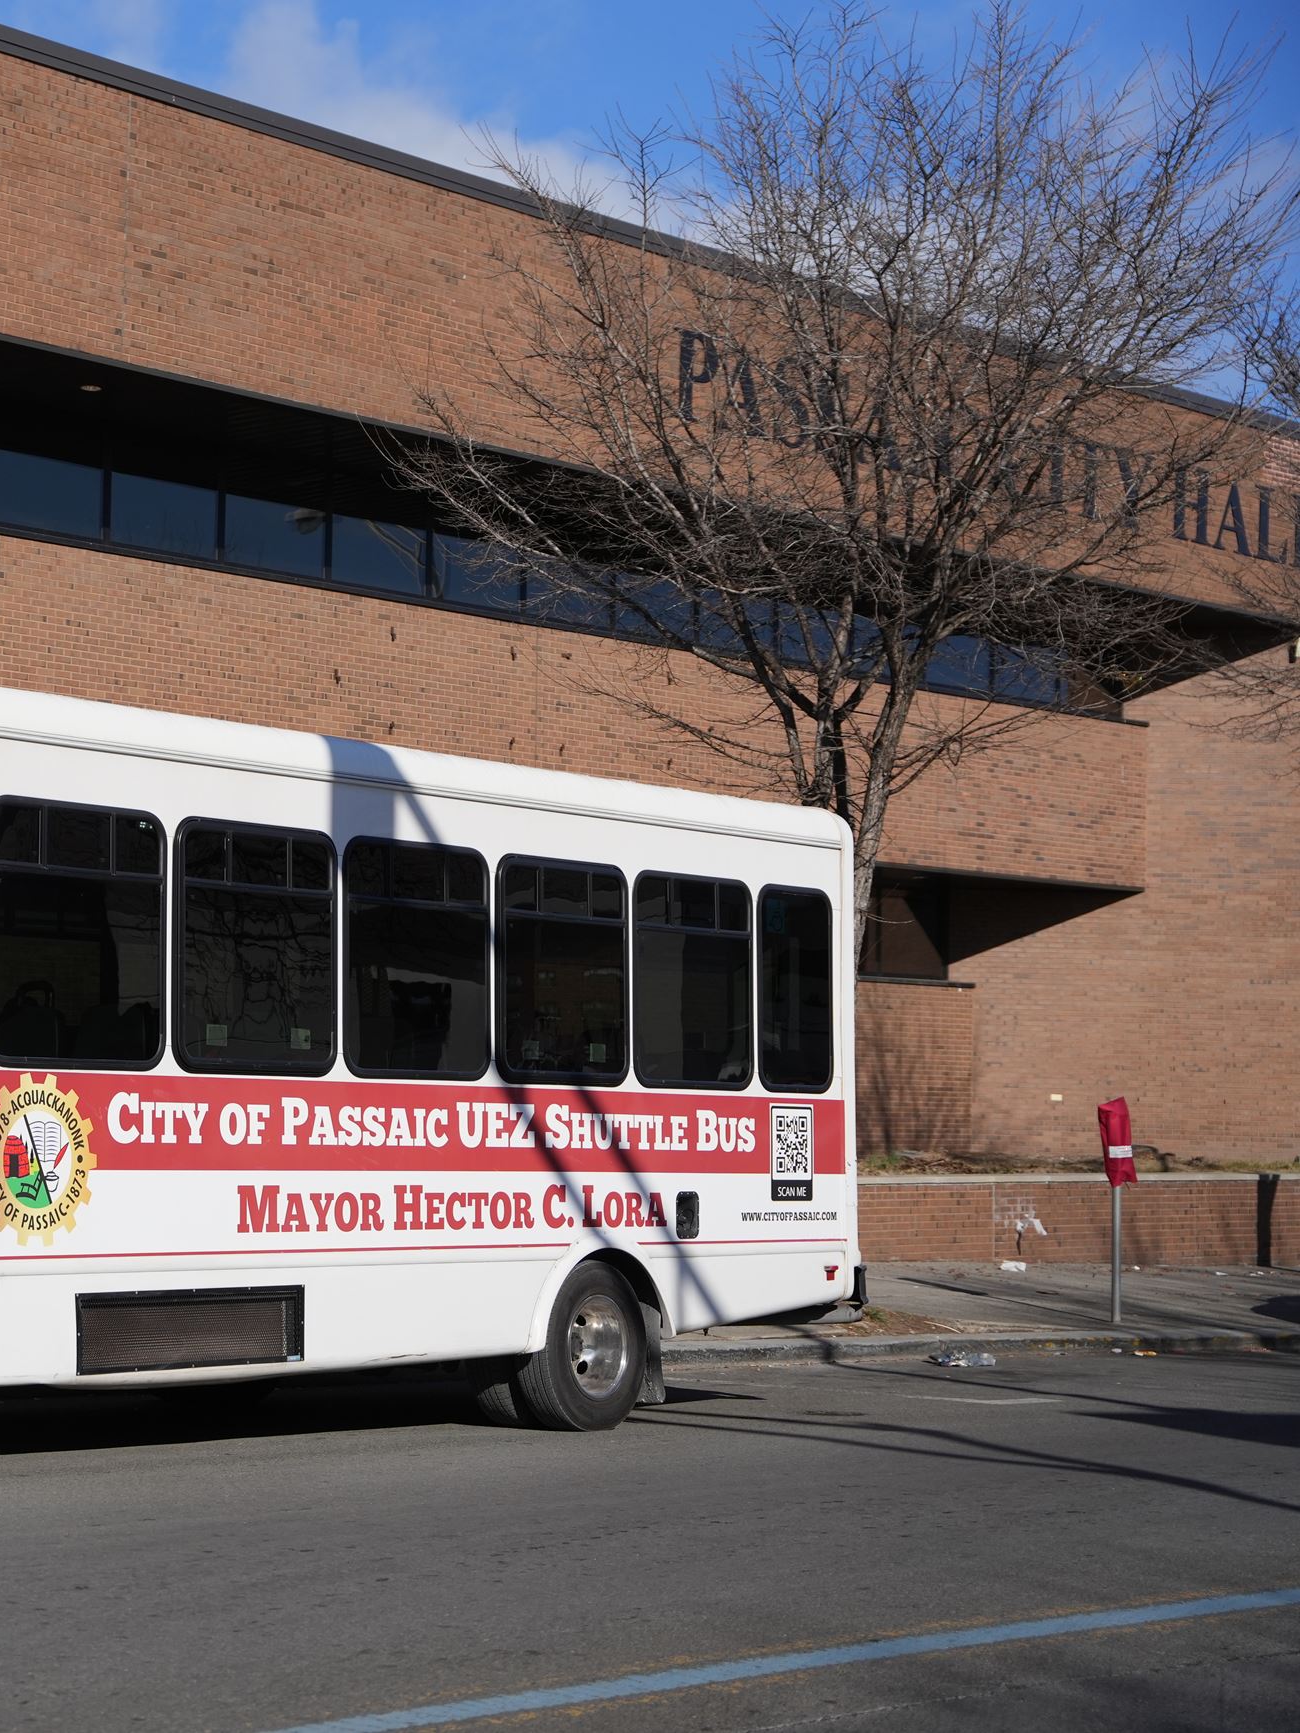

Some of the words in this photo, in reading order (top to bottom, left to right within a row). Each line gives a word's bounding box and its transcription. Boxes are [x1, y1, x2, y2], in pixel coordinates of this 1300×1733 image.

[107, 1092, 209, 1144] CITY
[219, 1103, 270, 1145] OF
[281, 1096, 448, 1148] PASSAIC
[456, 1102, 536, 1149] UEZ
[545, 1104, 688, 1152] SHUTTLE
[696, 1109, 756, 1153] BUS
[4, 1203, 19, 1222] OF
[21, 1169, 86, 1231] PASSAIC-1873
[237, 1185, 384, 1233] MAYOR
[394, 1184, 535, 1231] HECTOR
[542, 1183, 574, 1229] C.
[582, 1184, 668, 1229] LORA
[741, 1211, 838, 1221] WWW.CITYOFPASSAIC.COM
[777, 1186, 796, 1197] SCAN
[796, 1186, 807, 1197] ME
